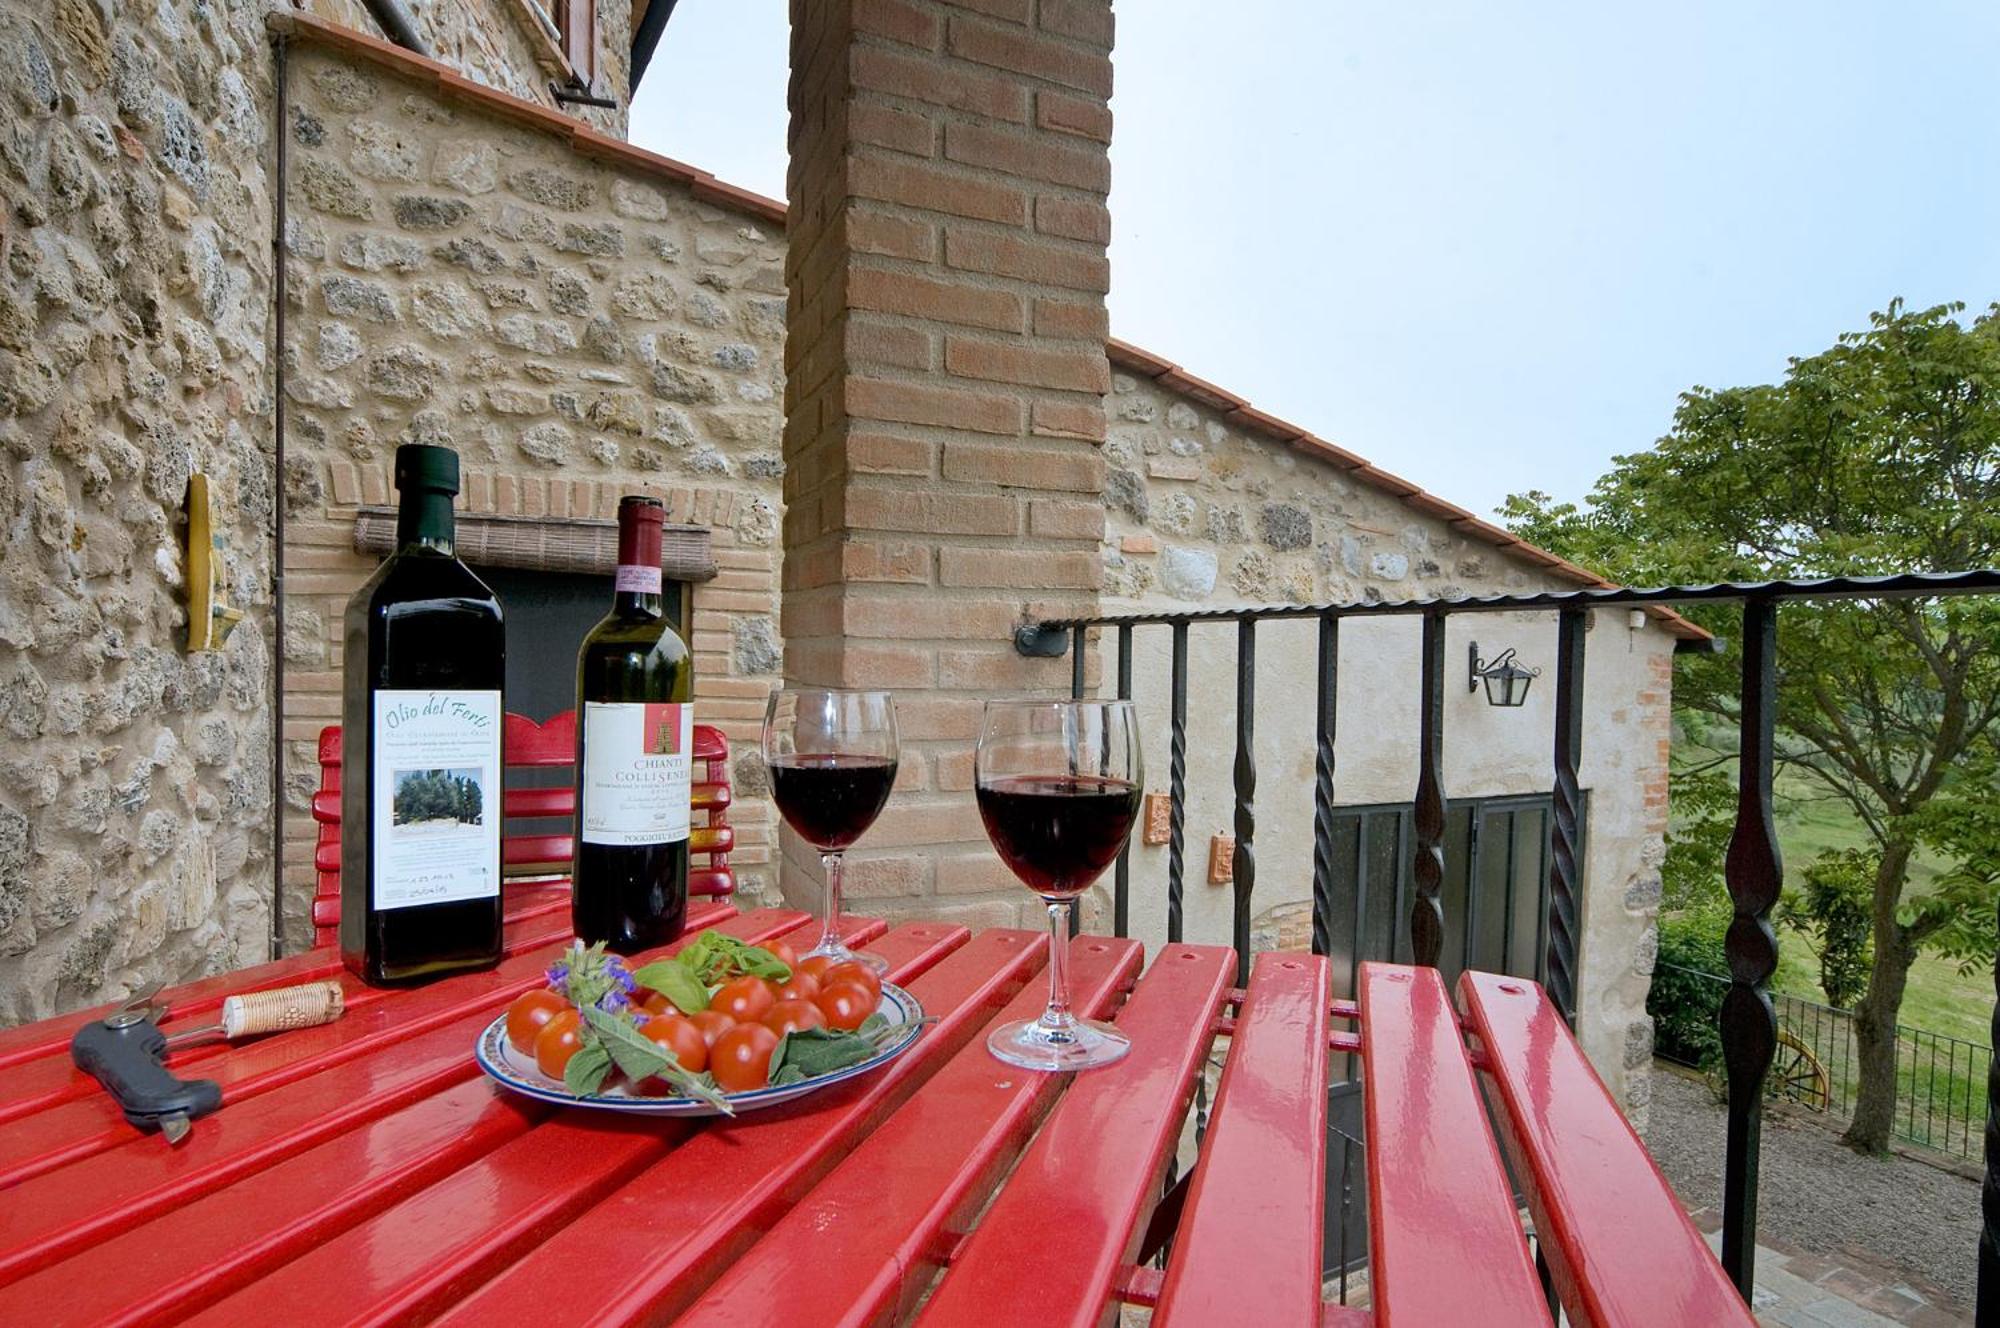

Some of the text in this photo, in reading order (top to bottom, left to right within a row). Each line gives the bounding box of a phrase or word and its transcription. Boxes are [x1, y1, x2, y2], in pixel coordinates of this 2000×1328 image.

[386, 703, 418, 729] Olio
[422, 692, 449, 716] del
[634, 758, 683, 771] CHIANTI
